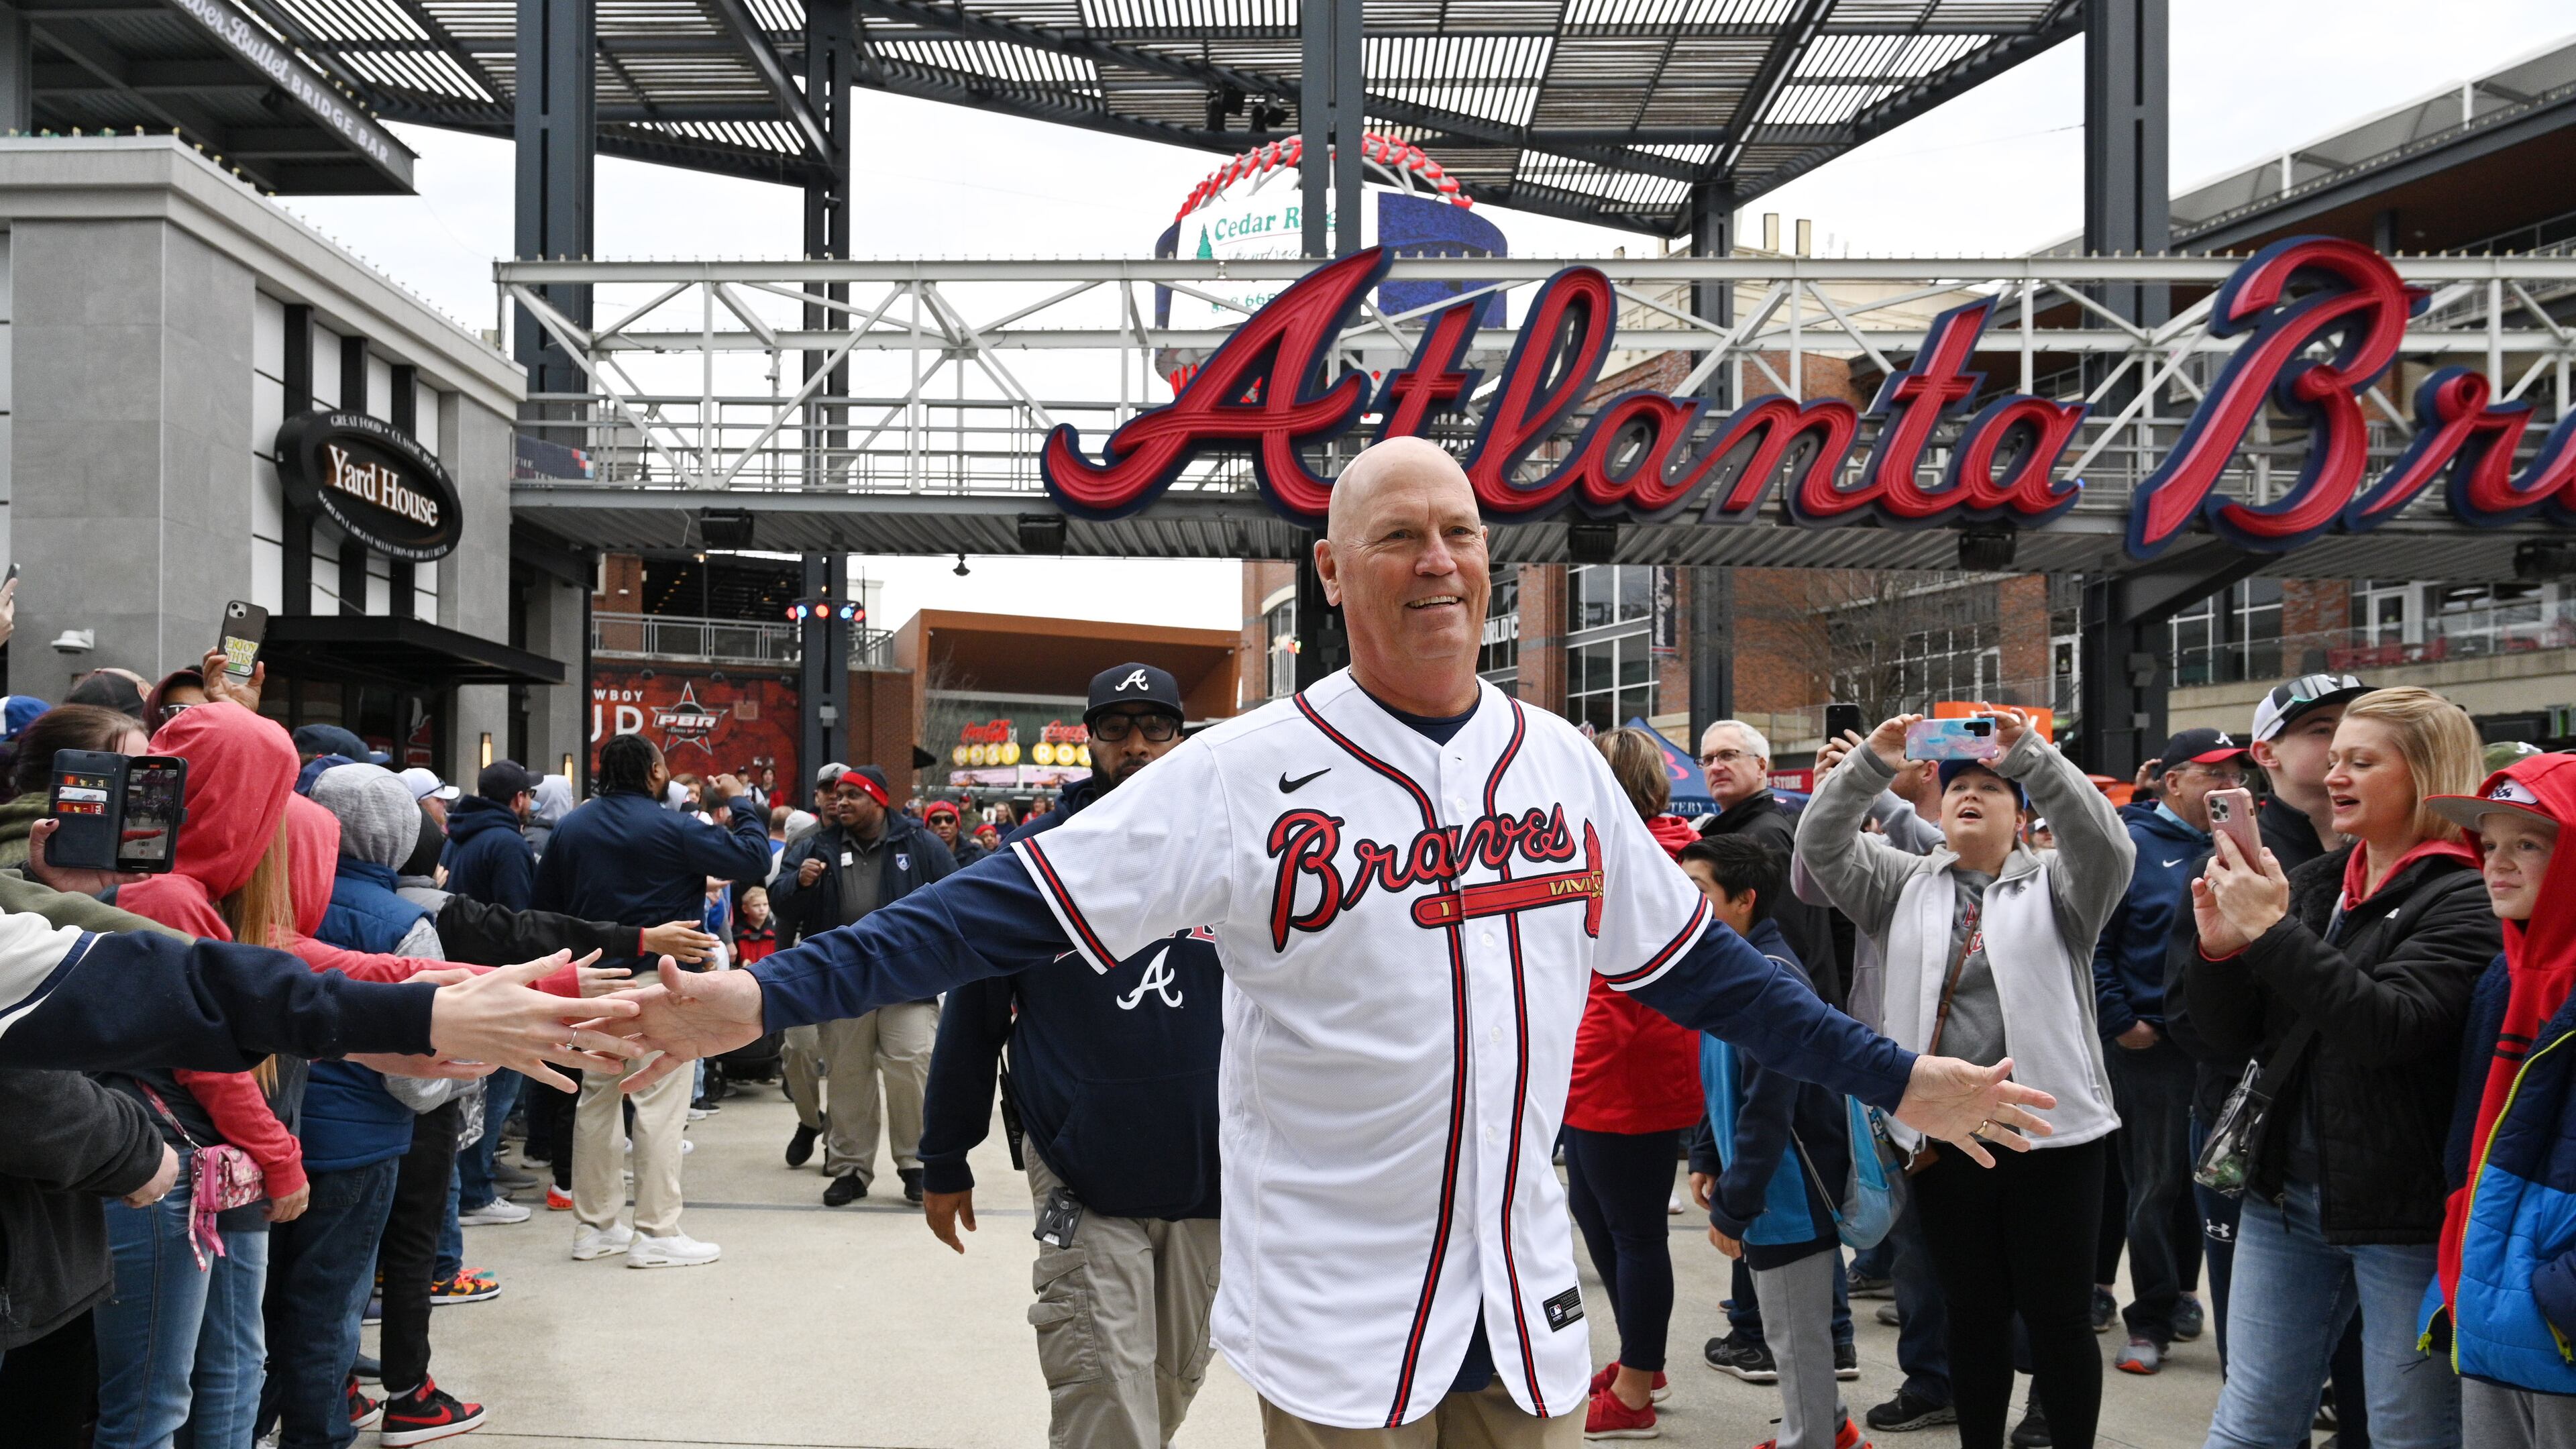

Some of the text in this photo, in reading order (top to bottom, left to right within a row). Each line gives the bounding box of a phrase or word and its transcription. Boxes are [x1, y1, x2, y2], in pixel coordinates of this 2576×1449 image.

[225, 16, 289, 83] Bullet
[291, 74, 354, 136] BRIDGE
[358, 127, 388, 164] BAR
[1215, 213, 1277, 241] Cedar
[1040, 235, 2576, 559] Atlanta Br
[359, 417, 382, 433] FOOD
[328, 443, 439, 527] Yard House
[227, 650, 252, 666] THIS
[1115, 669, 1149, 692] A
[658, 714, 717, 727] PBR
[956, 743, 1017, 764] ROXY
[1774, 774, 1803, 790] STORE
[1267, 802, 1576, 953] Braves
[1116, 945, 1183, 1010] A
